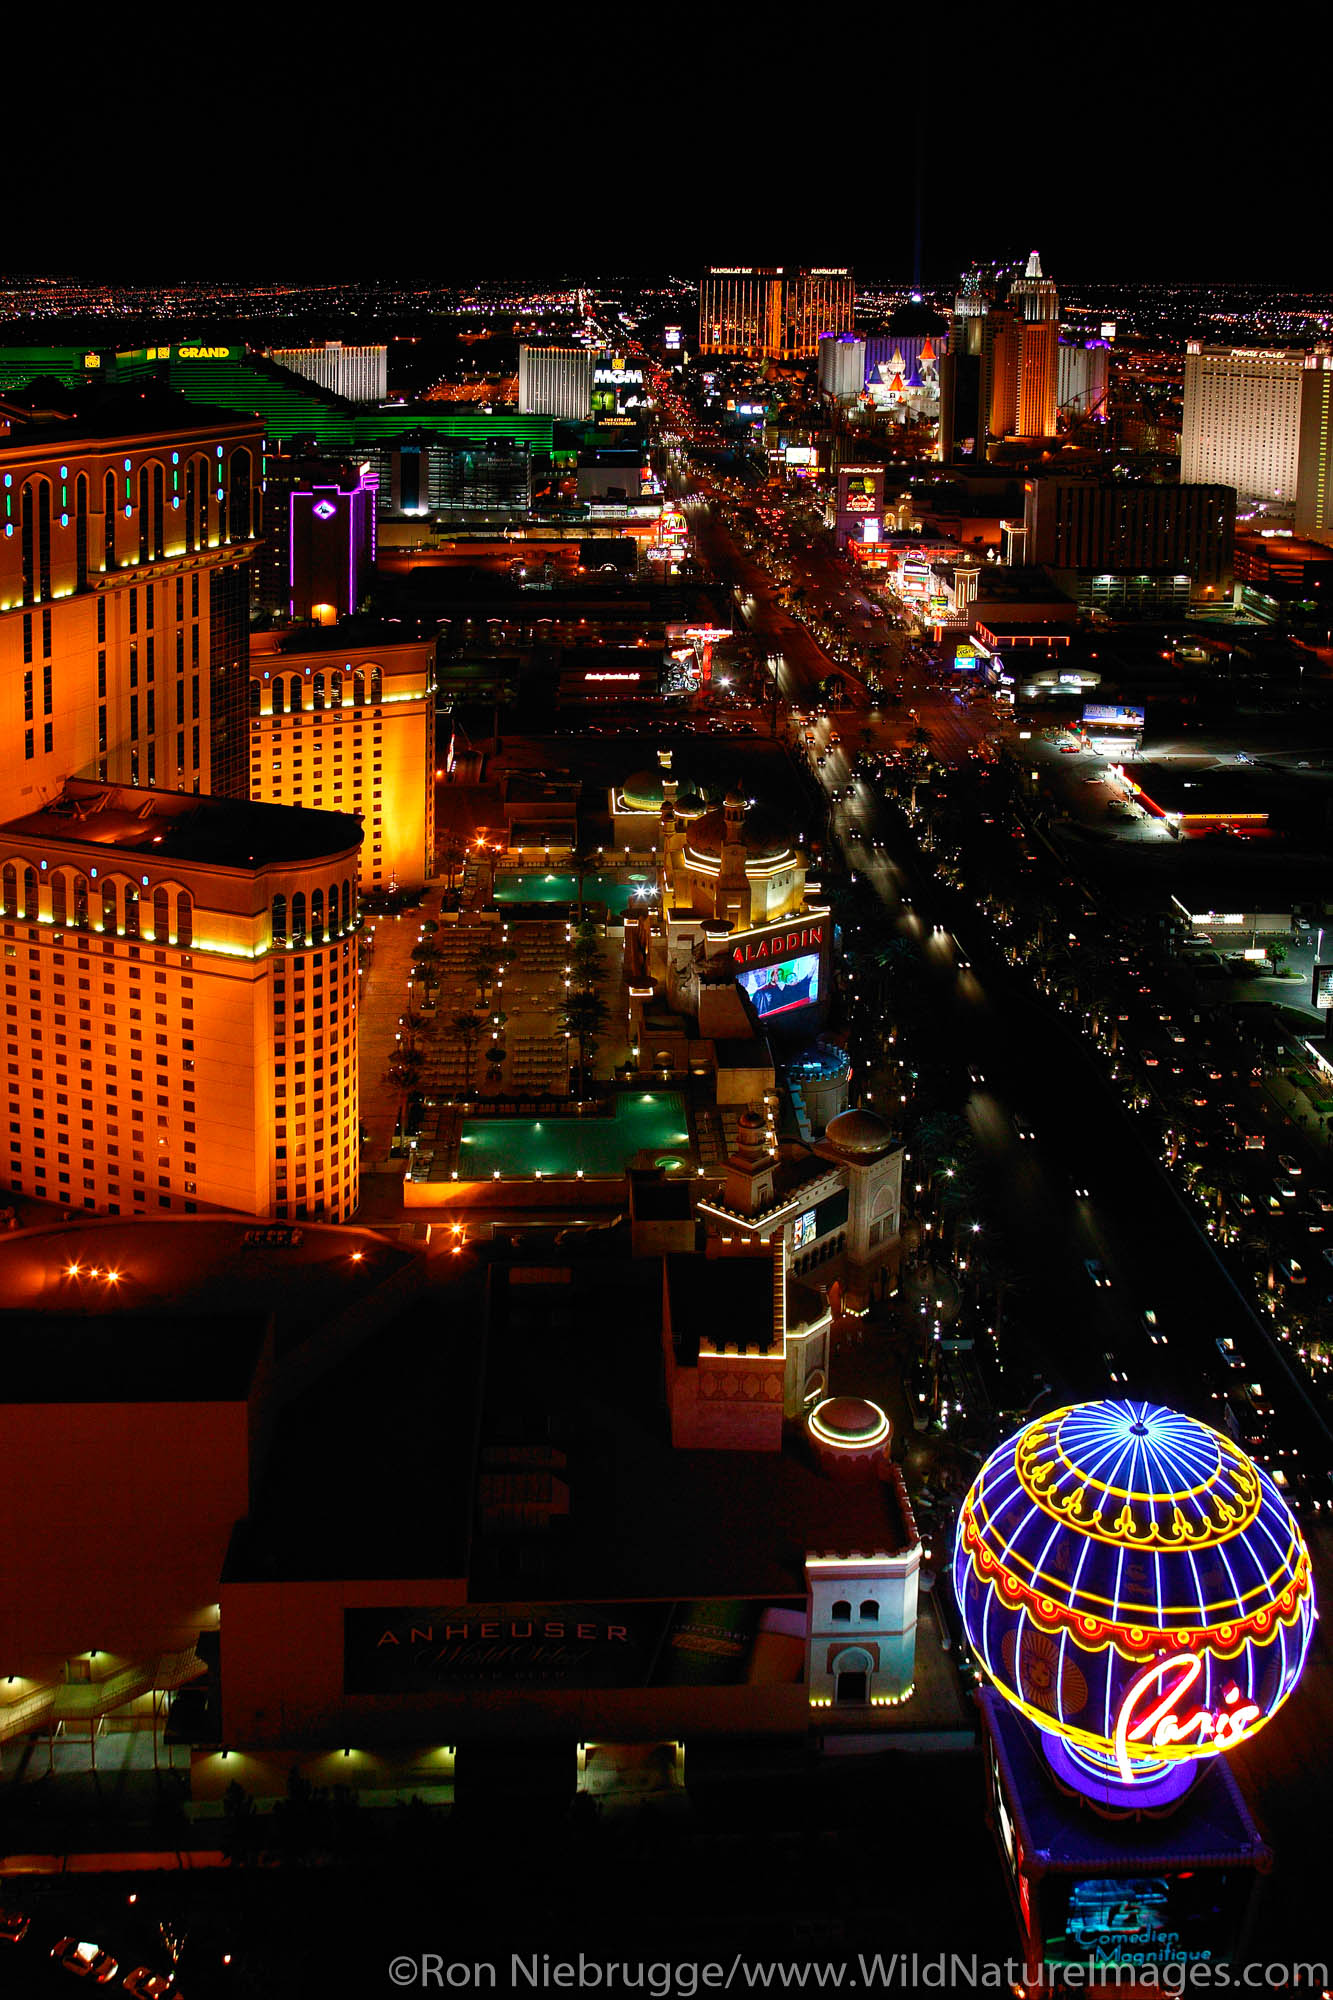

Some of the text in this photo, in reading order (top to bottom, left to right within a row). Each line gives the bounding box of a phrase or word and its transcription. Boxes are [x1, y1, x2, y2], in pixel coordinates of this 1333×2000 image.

[178, 347, 230, 358] GRAND
[1230, 349, 1286, 359] Monte Carlo
[594, 369, 643, 384] MGM
[733, 926, 823, 964] ALADDIN
[376, 1620, 634, 1649] ANHEUSER
[1116, 1652, 1260, 1784] Paris
[1076, 1923, 1180, 1949] Comedien
[1093, 1943, 1213, 1966] Magnifique
